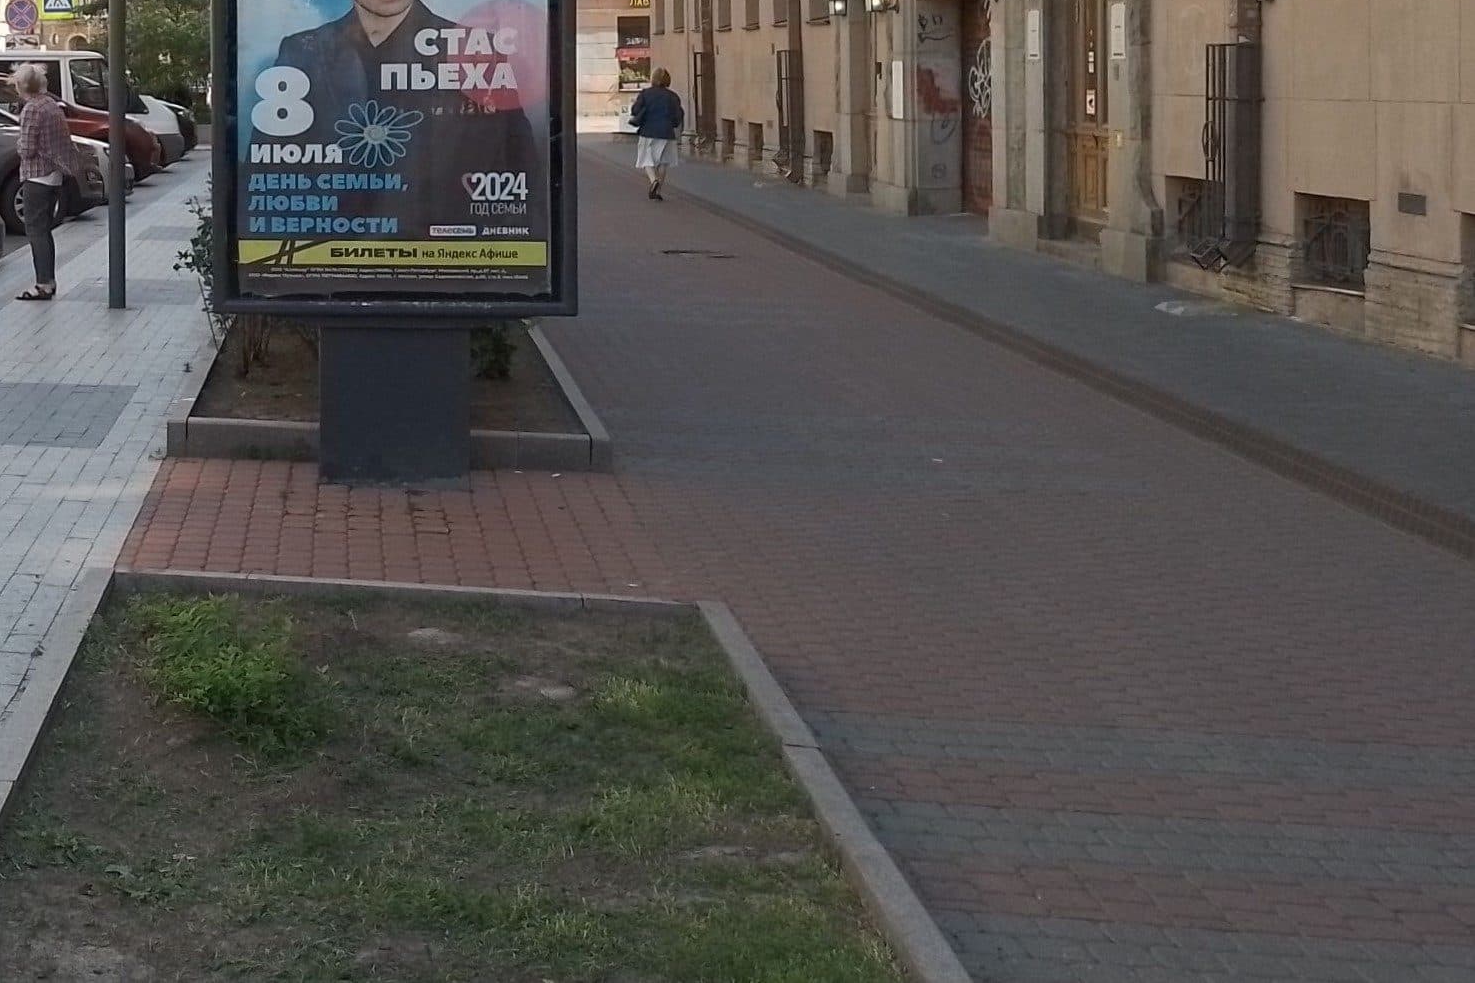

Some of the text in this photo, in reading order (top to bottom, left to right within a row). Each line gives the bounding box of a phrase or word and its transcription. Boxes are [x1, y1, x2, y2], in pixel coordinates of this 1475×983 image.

[414, 28, 518, 56] СТАС
[380, 63, 518, 90] ПЬЕХА
[251, 66, 314, 137] 8
[250, 144, 343, 164] ИЮЛЯ
[248, 173, 408, 192] ДЕНЬ СЕМЬИ,
[471, 172, 529, 201] 2024
[248, 195, 338, 211] ЛЮБВИ
[469, 202, 527, 216] ГОД СЕМЬИ
[249, 217, 399, 234] И ВЕРНОСТИ
[481, 226, 530, 236] ДНЕВНИК
[330, 248, 418, 258] БИЛЕТЫ
[438, 249, 476, 259] Яндекс
[479, 248, 519, 259] Афише
